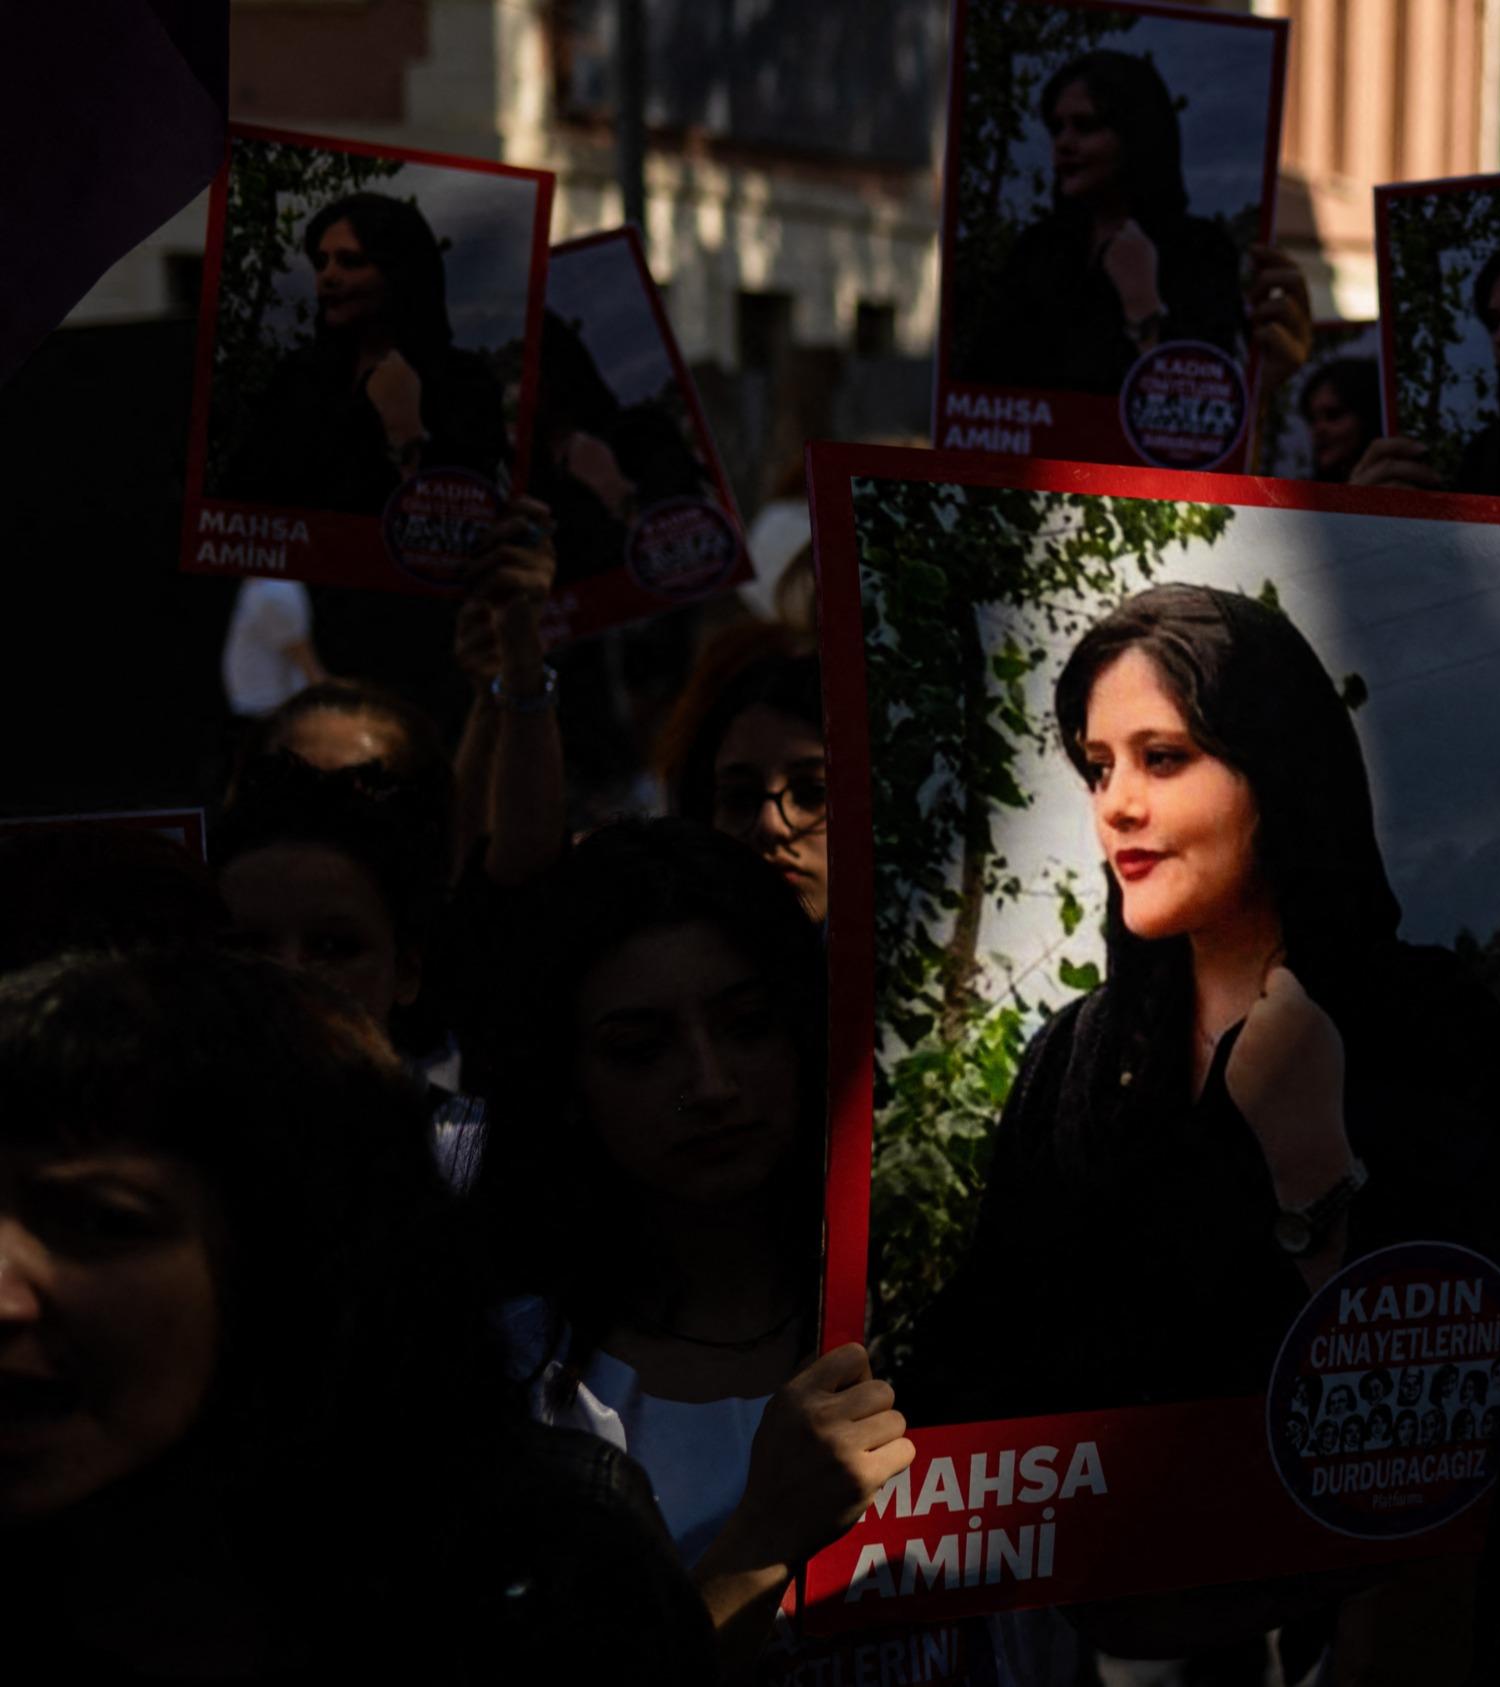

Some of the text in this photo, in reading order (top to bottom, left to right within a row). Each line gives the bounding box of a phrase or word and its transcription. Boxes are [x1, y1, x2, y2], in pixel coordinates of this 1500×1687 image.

[945, 392, 1054, 428] MAHSA
[199, 506, 310, 545] MAHSA
[1338, 1278, 1484, 1325] KADIN
[858, 1440, 1109, 1523] MAHSA
[843, 1505, 1057, 1605] AMİNİ
